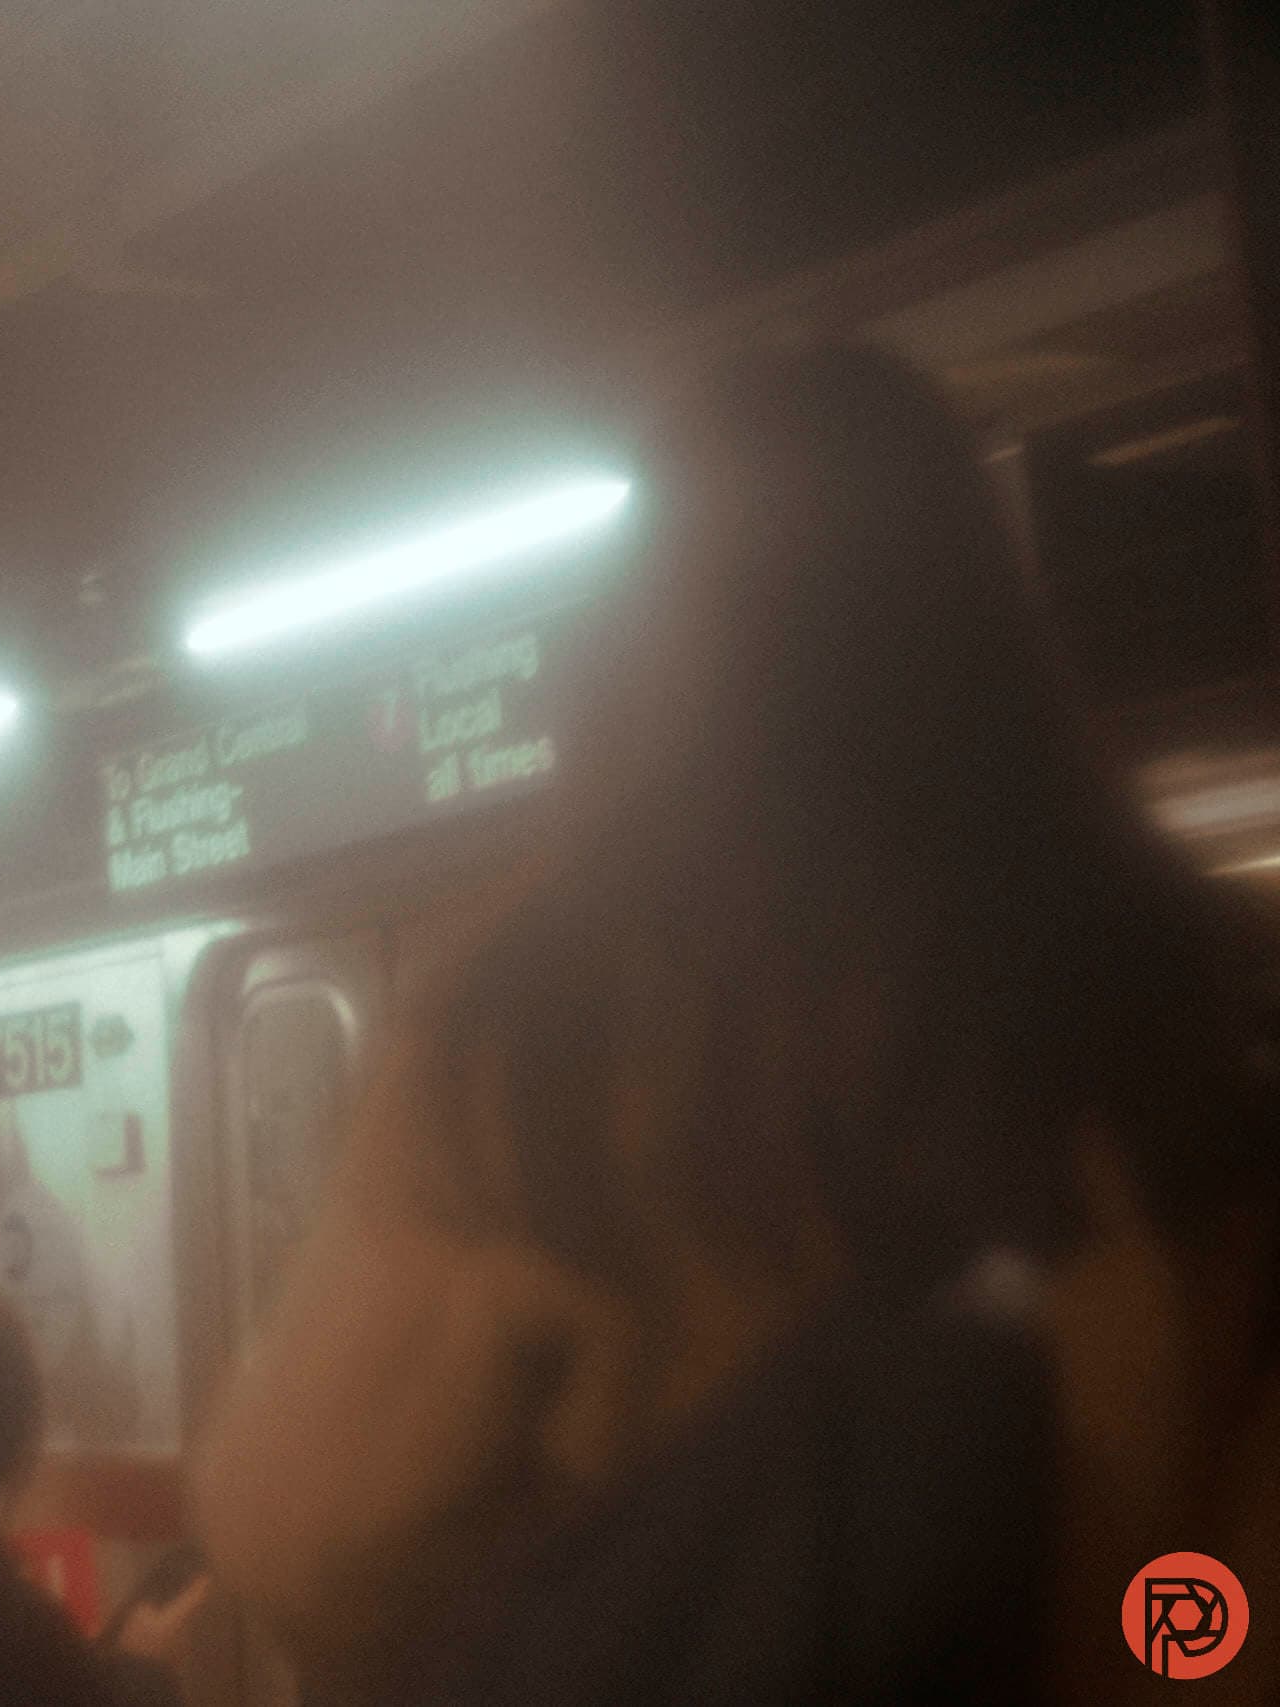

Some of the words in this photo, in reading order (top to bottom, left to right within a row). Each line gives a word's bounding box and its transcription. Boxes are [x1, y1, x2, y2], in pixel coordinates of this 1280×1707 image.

[136, 734, 210, 792] Grand
[217, 697, 308, 766] Central
[419, 687, 503, 755] Local
[425, 753, 461, 804] all
[467, 737, 556, 791] times
[108, 846, 167, 892] Main
[171, 819, 251, 875] Street
